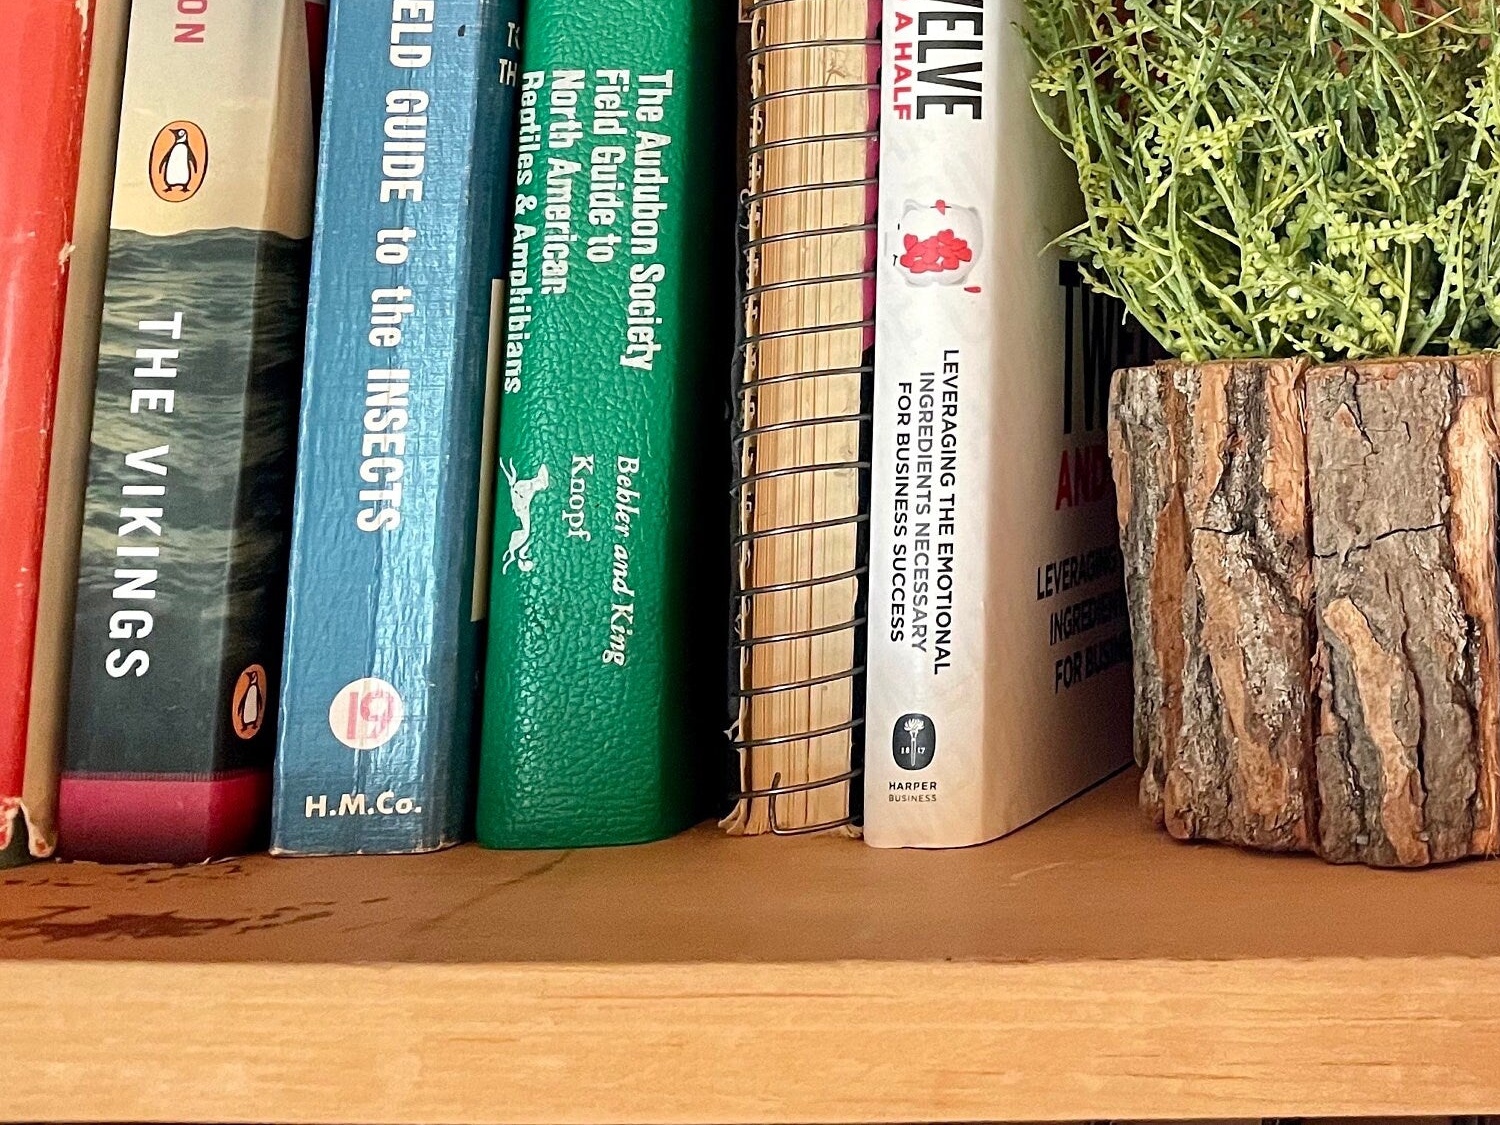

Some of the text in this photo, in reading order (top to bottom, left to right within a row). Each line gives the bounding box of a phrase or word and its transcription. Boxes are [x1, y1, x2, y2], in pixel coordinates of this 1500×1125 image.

[895, 12, 913, 32] A
[894, 43, 912, 120] HALF
[380, 90, 429, 202] GUIDE
[541, 70, 585, 294] North American
[587, 70, 630, 262] Field Guide to
[376, 225, 417, 266] to
[505, 70, 546, 394] Reptiles & Amphibians
[620, 70, 673, 370] The Audubon Society
[369, 287, 415, 348] the
[358, 370, 411, 532] INSECTS
[107, 312, 183, 678] THE VIKINGS
[562, 453, 594, 541] Knopf
[891, 383, 912, 641] FOR BUSINESS SUCCESS
[912, 373, 934, 652] INGREDIENTS NECESSARY
[935, 350, 959, 675] LEVERAGING THE EMOTIONAL
[613, 544, 634, 597] and
[602, 603, 633, 666] King
[1055, 651, 1082, 694] FOR
[345, 689, 393, 742] 19
[305, 794, 423, 817] H.M.Co.
[889, 781, 937, 790] HARPER
[889, 794, 937, 802] BUSINESS
